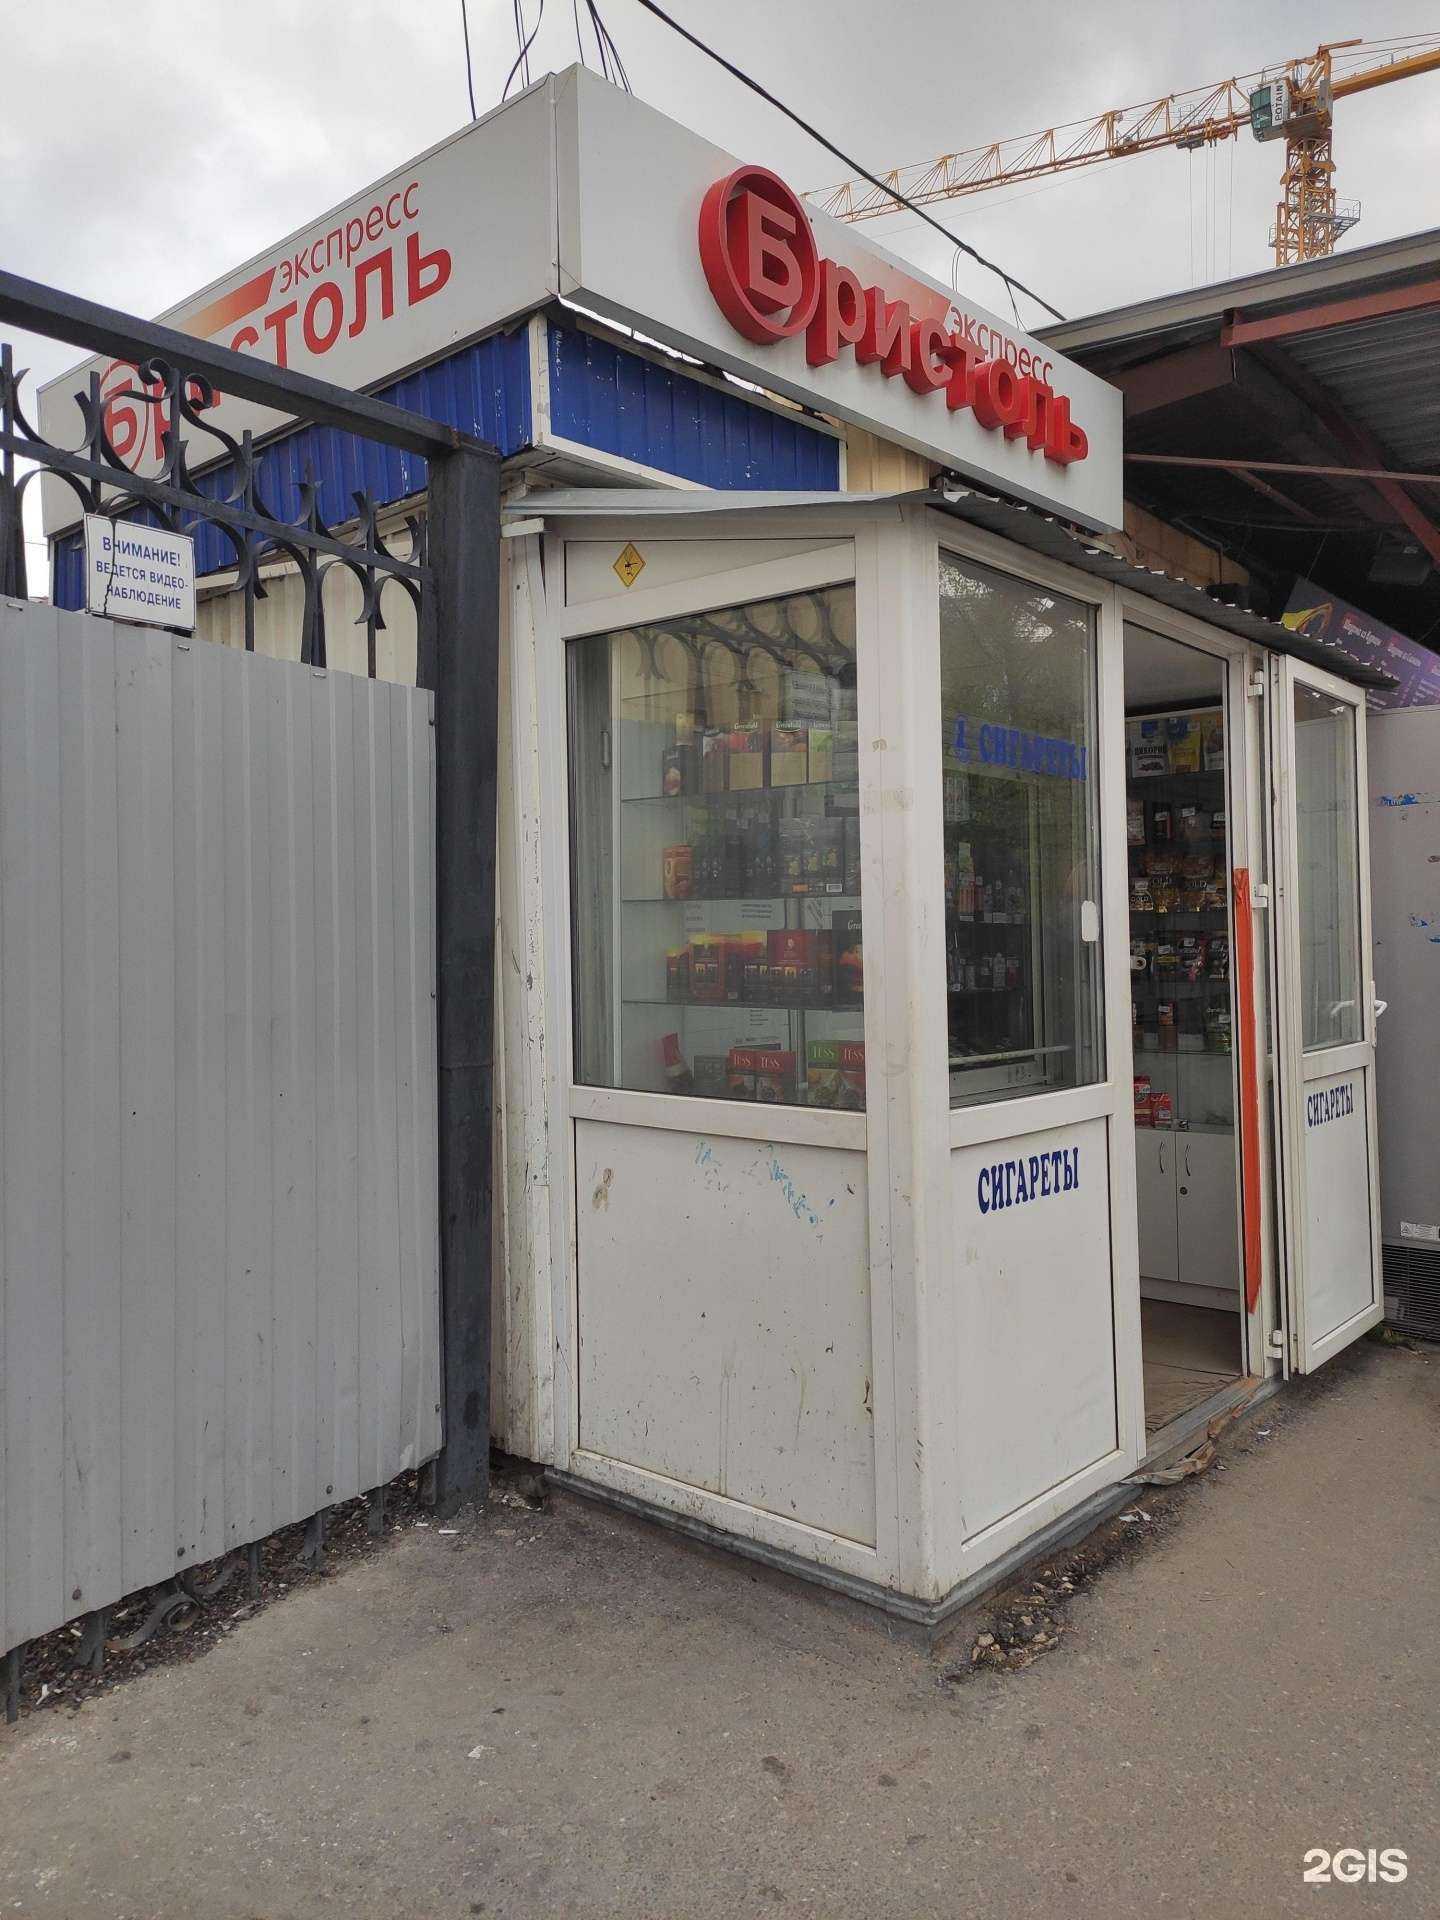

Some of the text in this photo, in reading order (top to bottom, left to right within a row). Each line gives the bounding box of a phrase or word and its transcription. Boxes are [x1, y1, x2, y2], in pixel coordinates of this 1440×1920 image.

[1275, 85, 1284, 121] POTAIN
[279, 182, 420, 293] экспресс
[699, 165, 1089, 466] Бристоль
[102, 536, 181, 567] ВНИМАНИЕ!
[96, 560, 189, 590] ВЕДЕТСЯ ВИДЕО-
[107, 584, 182, 610] НАБЛЮДЕНИЕ
[1307, 1082, 1354, 1128] СИГАРЕТЫ
[977, 1146, 1079, 1215] СИГАРЕТЫ
